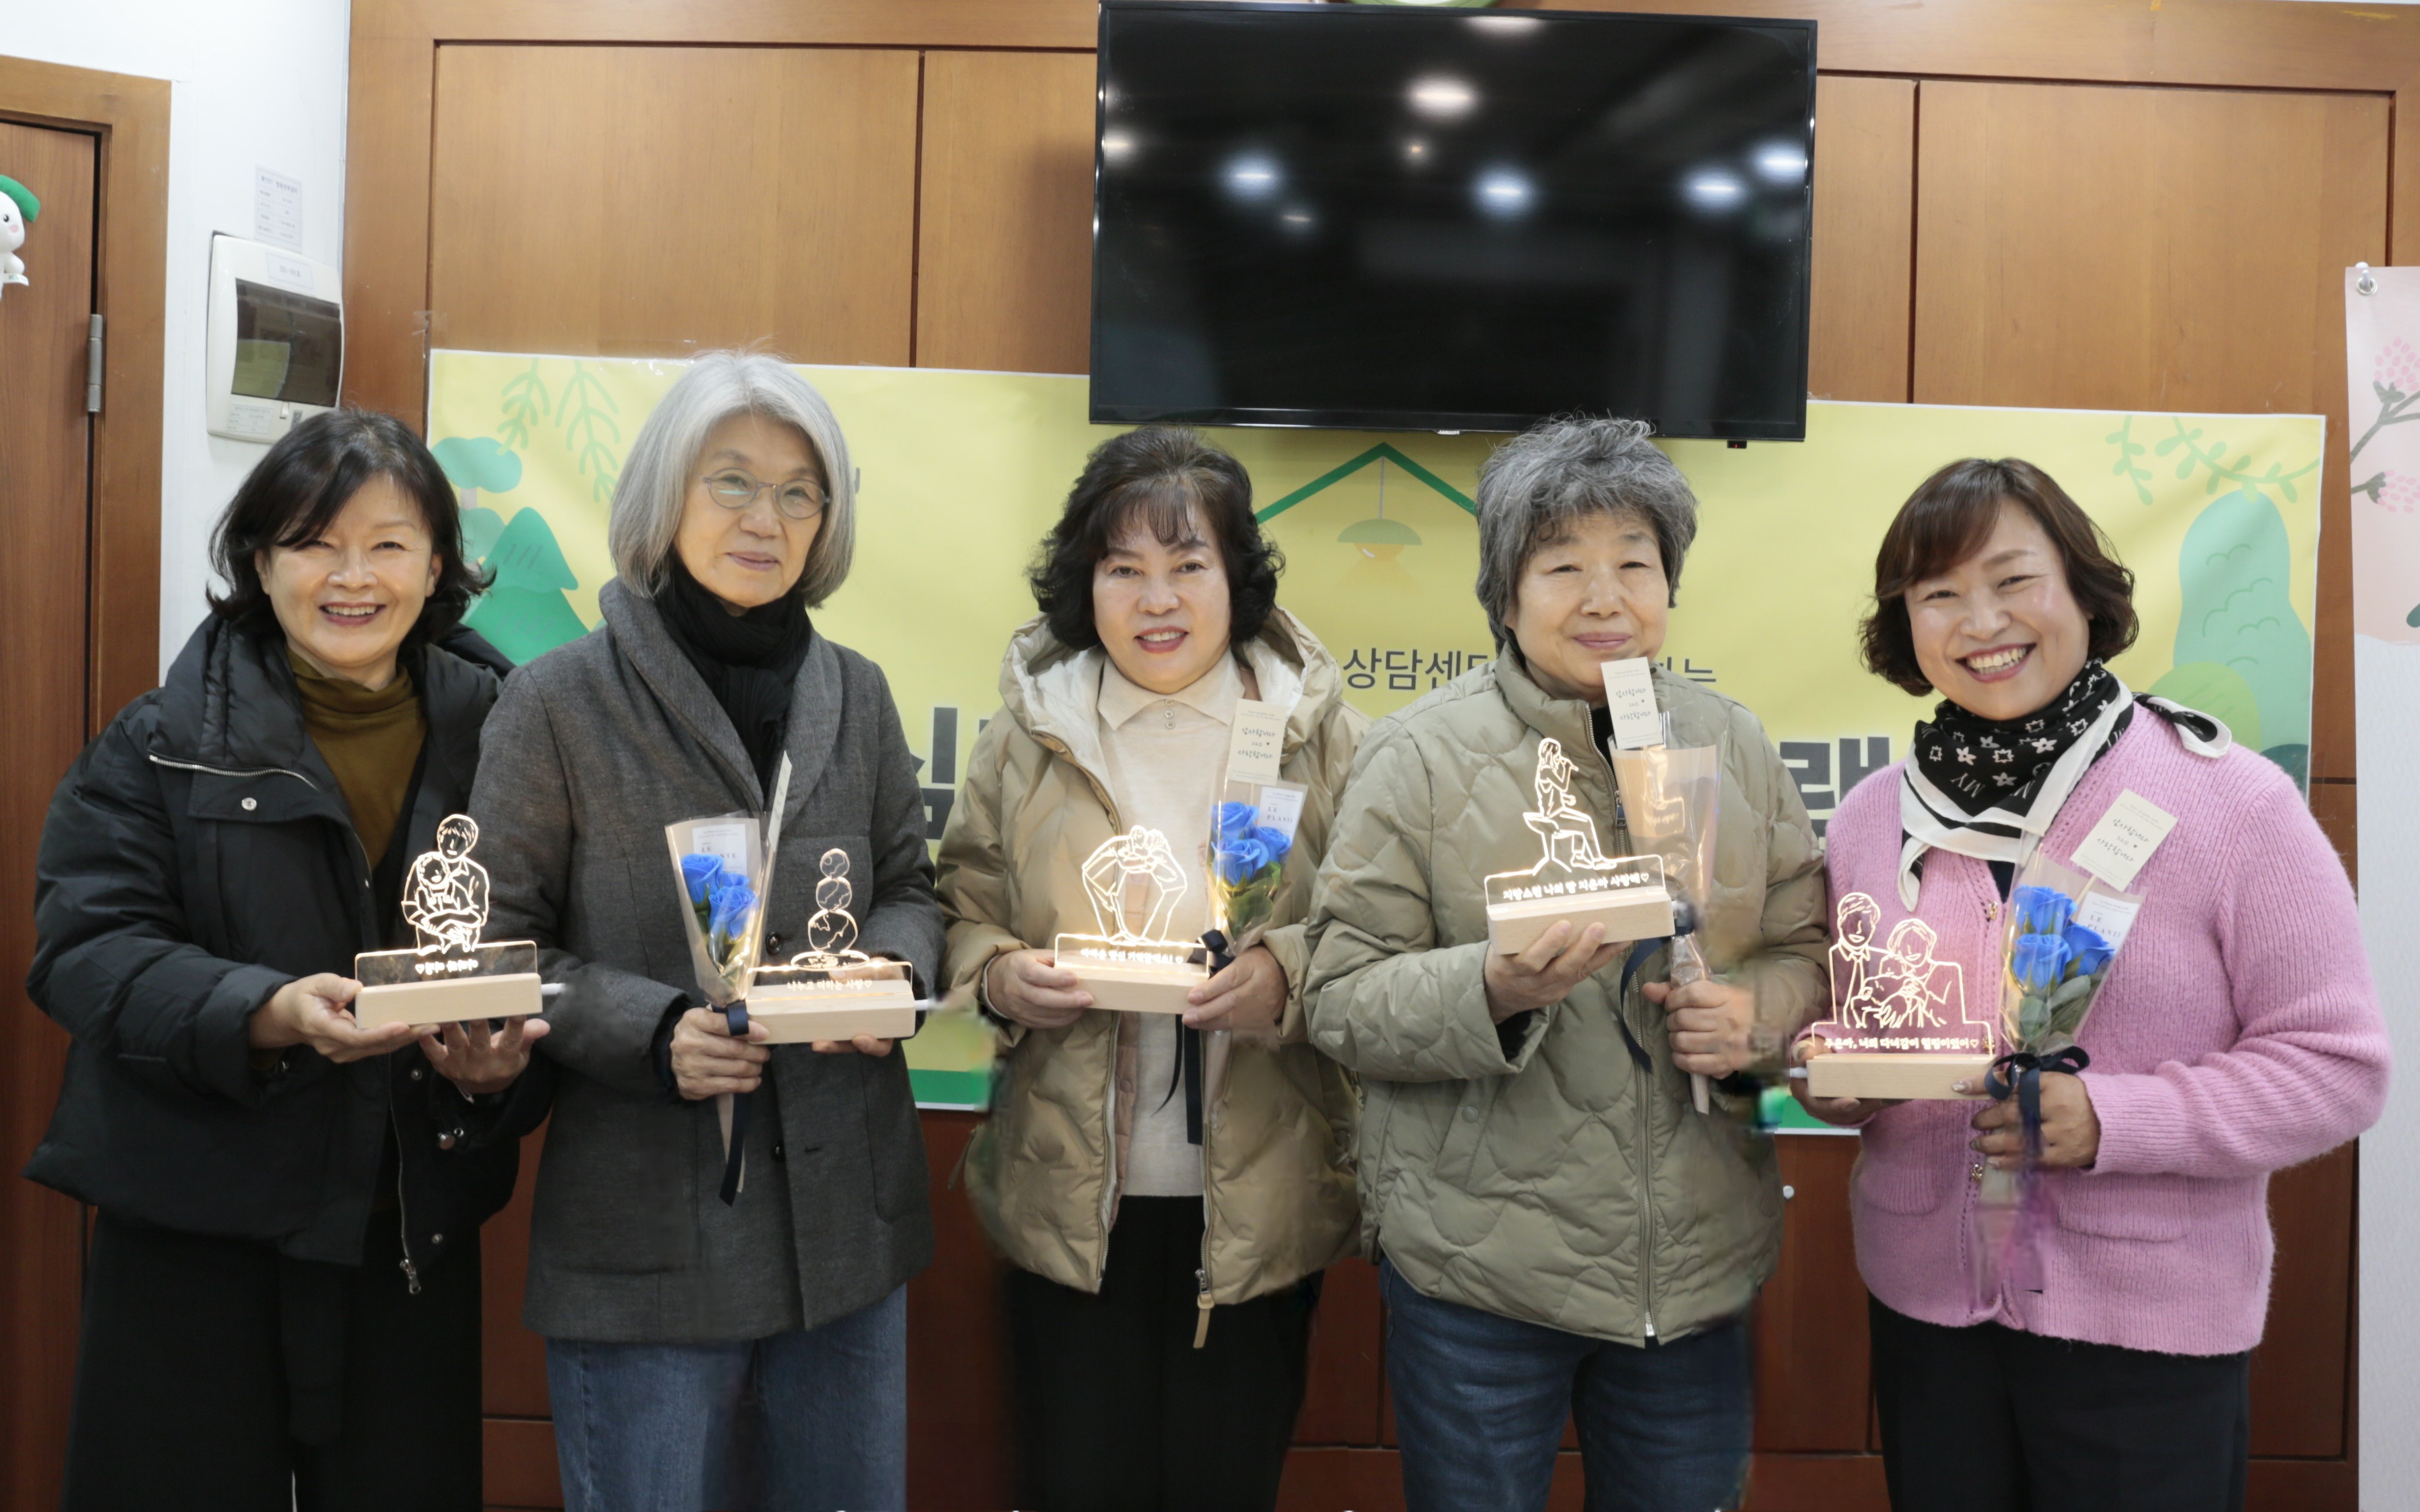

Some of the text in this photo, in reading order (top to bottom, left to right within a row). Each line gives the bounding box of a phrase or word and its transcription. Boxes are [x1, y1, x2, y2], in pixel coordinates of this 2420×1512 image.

[1242, 726, 1276, 738] 감사합니다
[1238, 749, 1273, 759] 사랑합니다
[2112, 818, 2150, 843] 감사합니다
[2096, 838, 2135, 862] 사랑합니다
